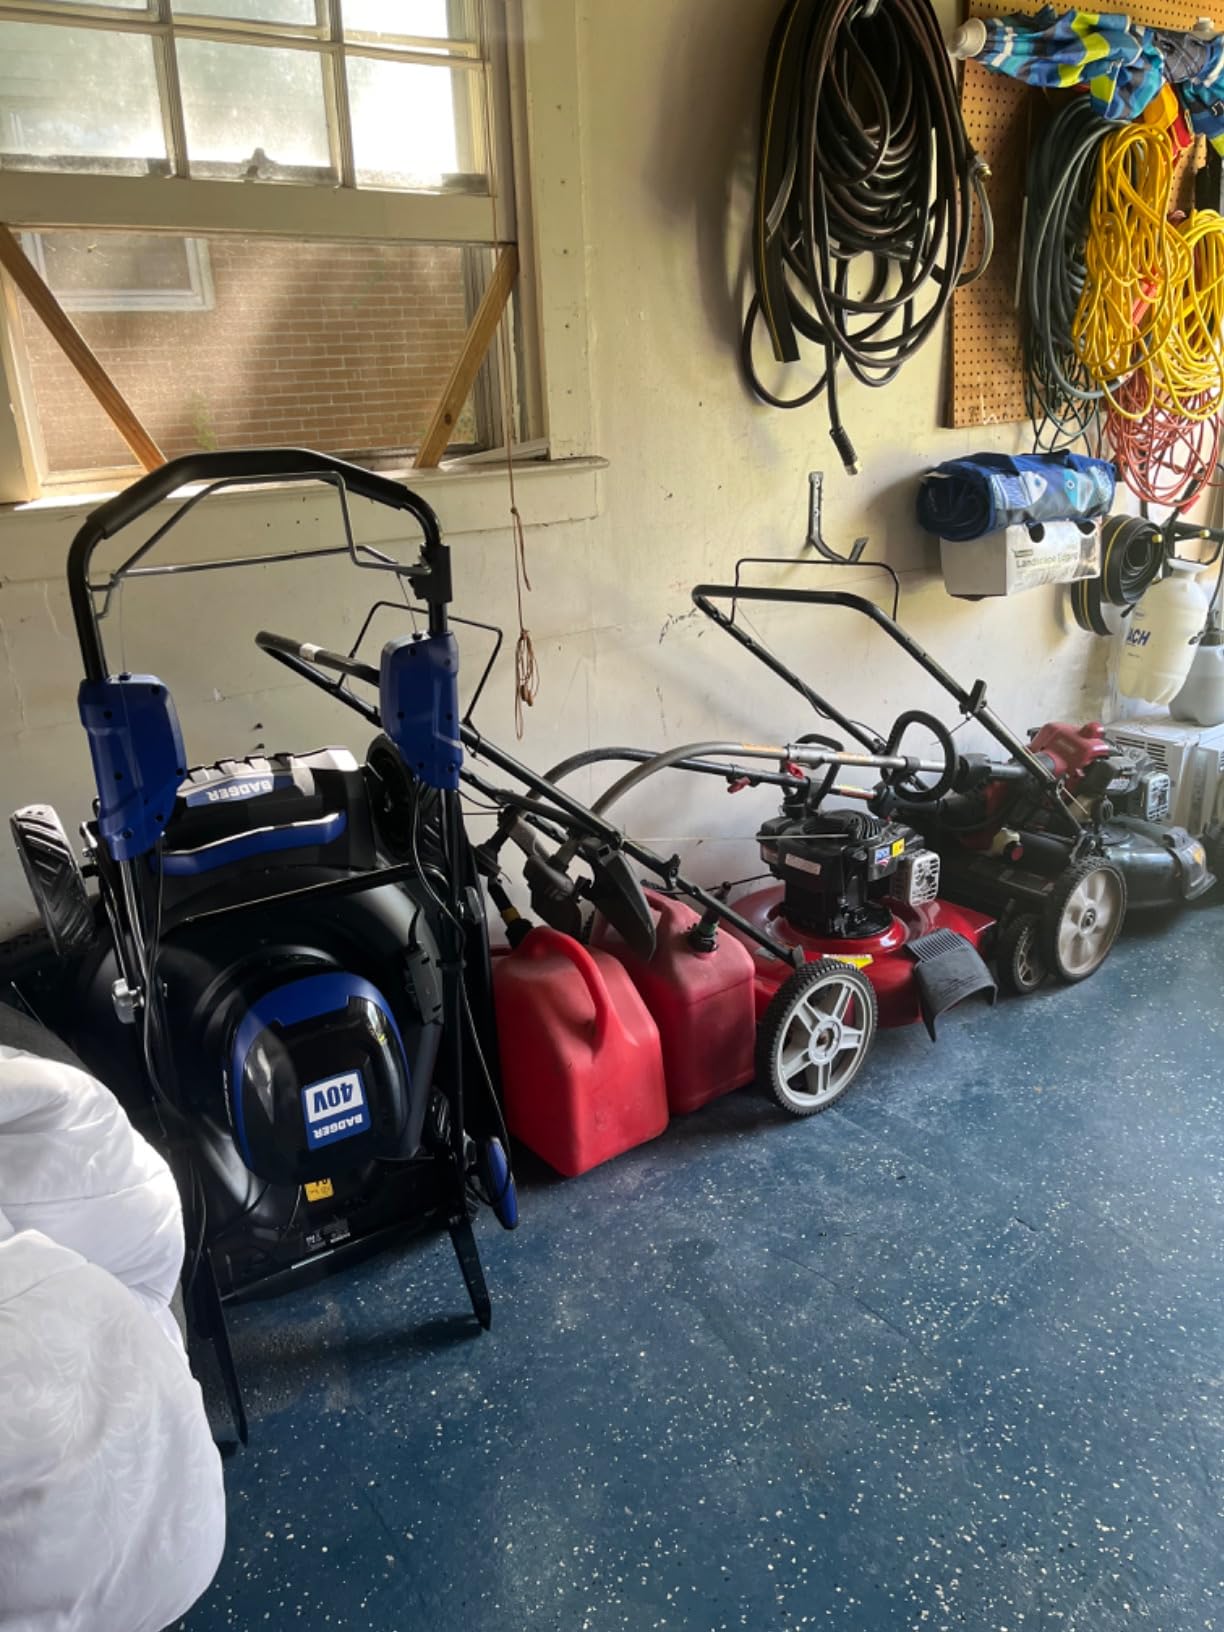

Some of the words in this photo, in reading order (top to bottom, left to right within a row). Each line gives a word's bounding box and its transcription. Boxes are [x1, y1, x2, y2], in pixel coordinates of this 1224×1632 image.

[206, 780, 273, 801] BADGER
[313, 1082, 353, 1114] 40V
[312, 1113, 363, 1139] BADGER
